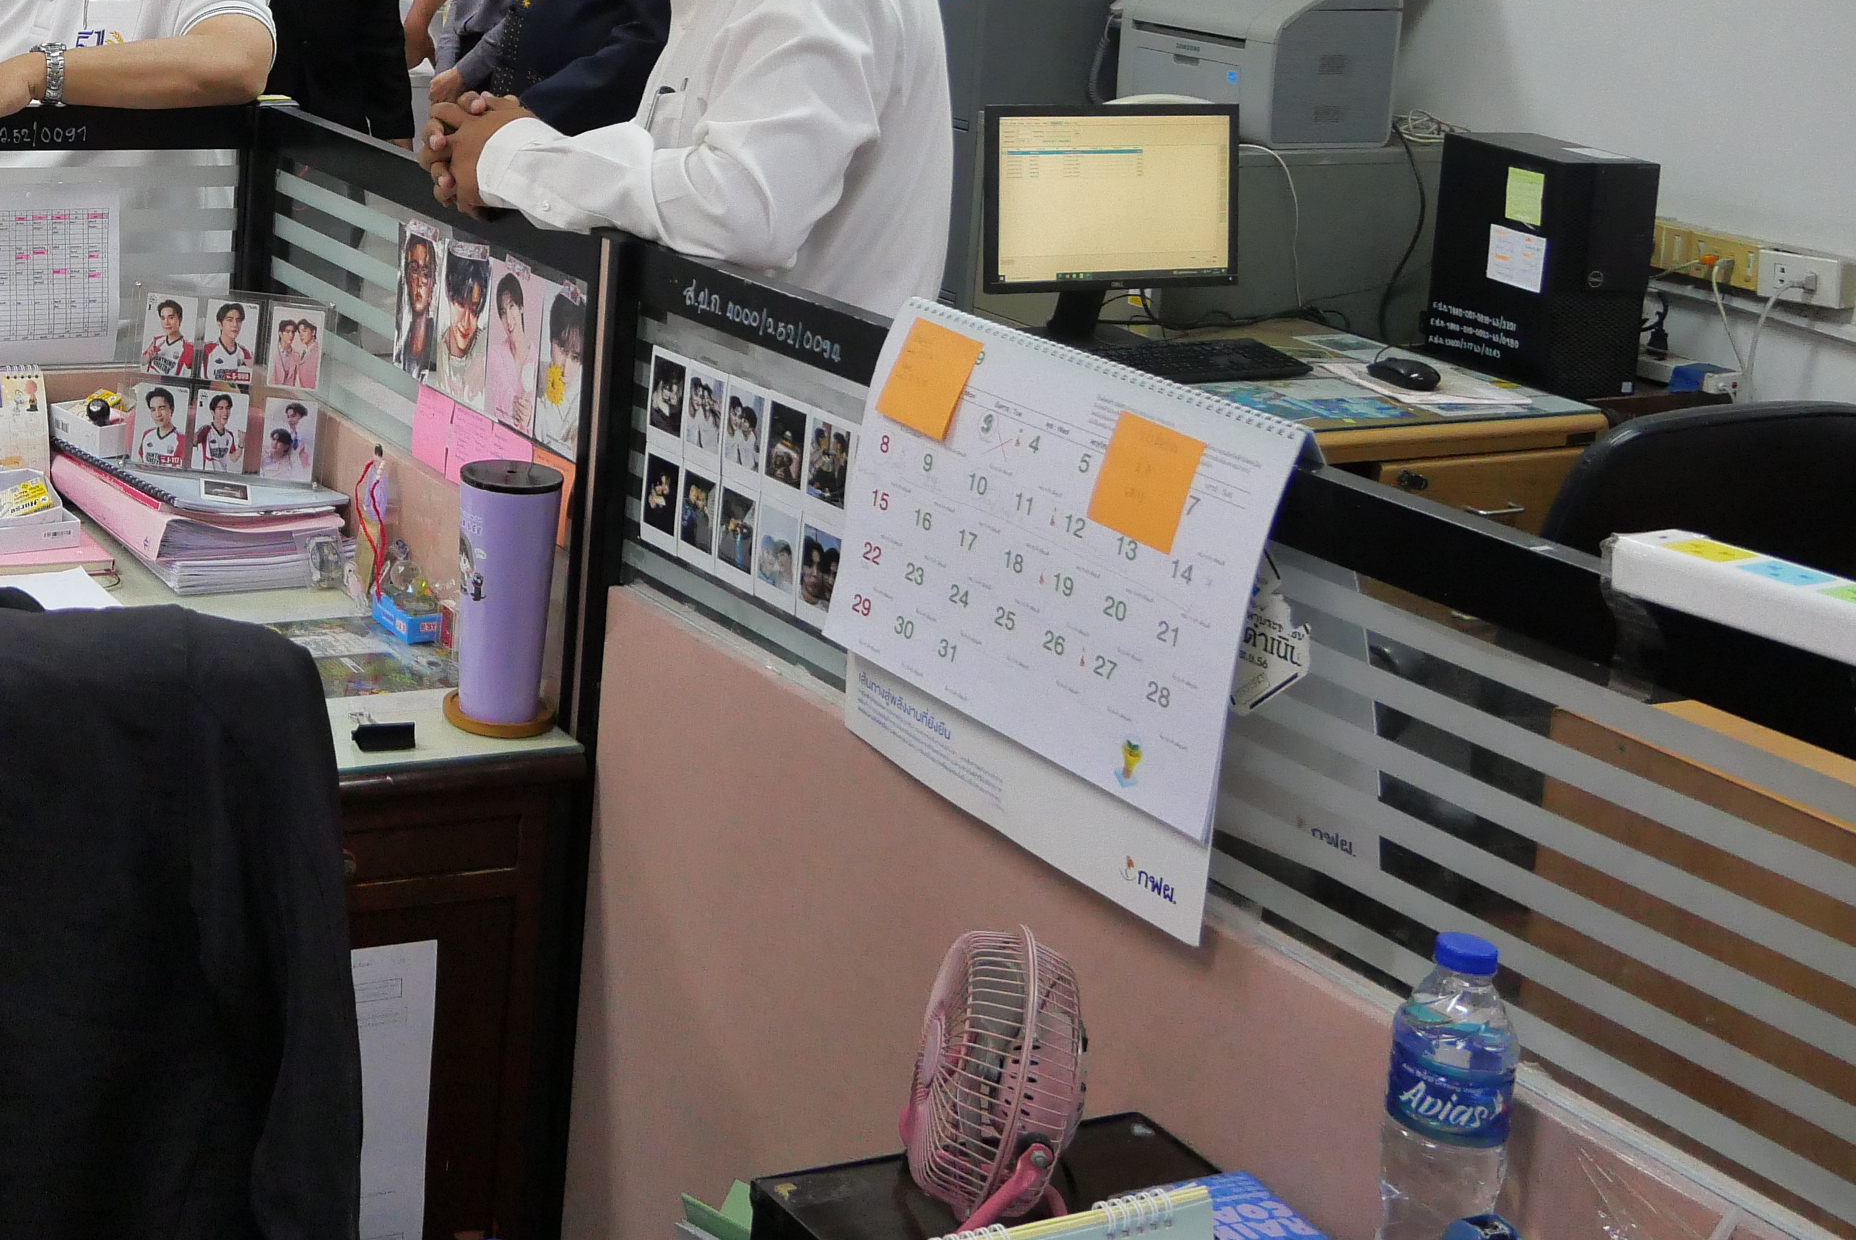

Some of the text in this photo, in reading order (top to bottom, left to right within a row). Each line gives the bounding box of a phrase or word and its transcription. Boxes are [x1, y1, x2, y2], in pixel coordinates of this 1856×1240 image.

[880, 435, 1193, 585] 8 9 10 11 12 13 14
[1028, 435, 1041, 454] 4
[1078, 453, 1092, 473] 5
[1187, 495, 1201, 516] 7
[862, 542, 1171, 708] 22 23 24 25 26 27 28
[872, 489, 1179, 647] 15 16 17 18 19 20 21
[851, 594, 957, 662] 29 30 31
[1137, 870, 1177, 904] กฟผ.
